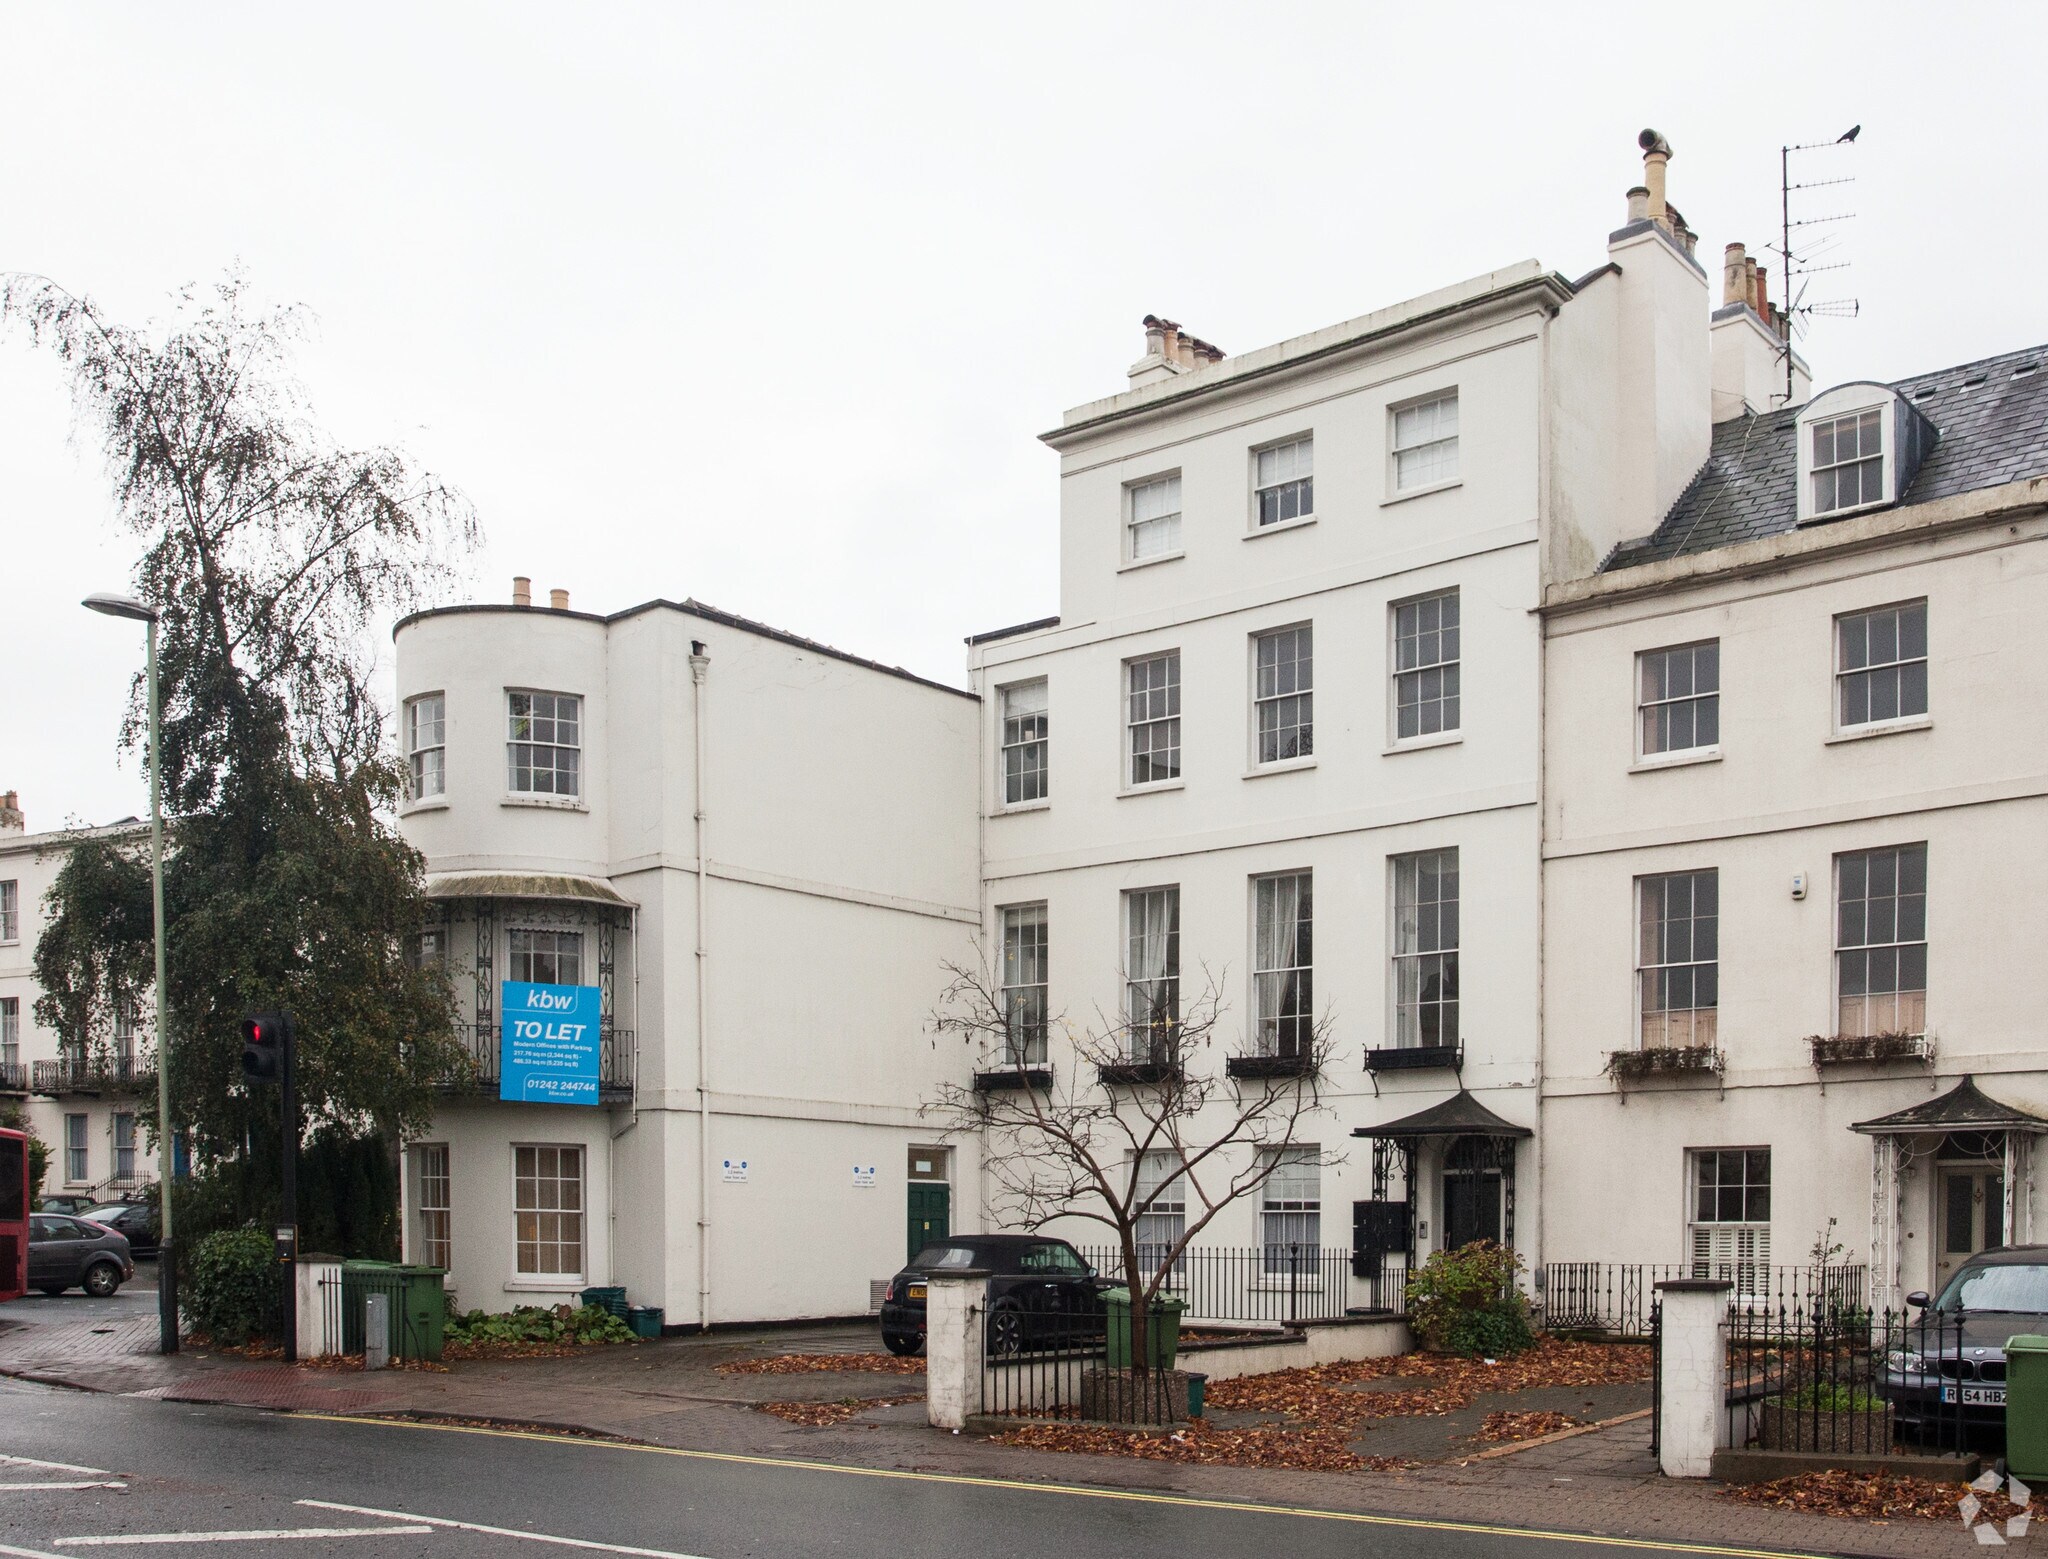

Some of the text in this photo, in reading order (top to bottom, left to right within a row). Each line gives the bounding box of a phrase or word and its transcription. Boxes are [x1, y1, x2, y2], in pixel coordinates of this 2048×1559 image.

[527, 990, 572, 1010] kbw
[514, 1021, 587, 1042] TO LET
[570, 1044, 593, 1052] Parking
[527, 1080, 596, 1091] 01242 244744
[1947, 1388, 1980, 1402] R54
